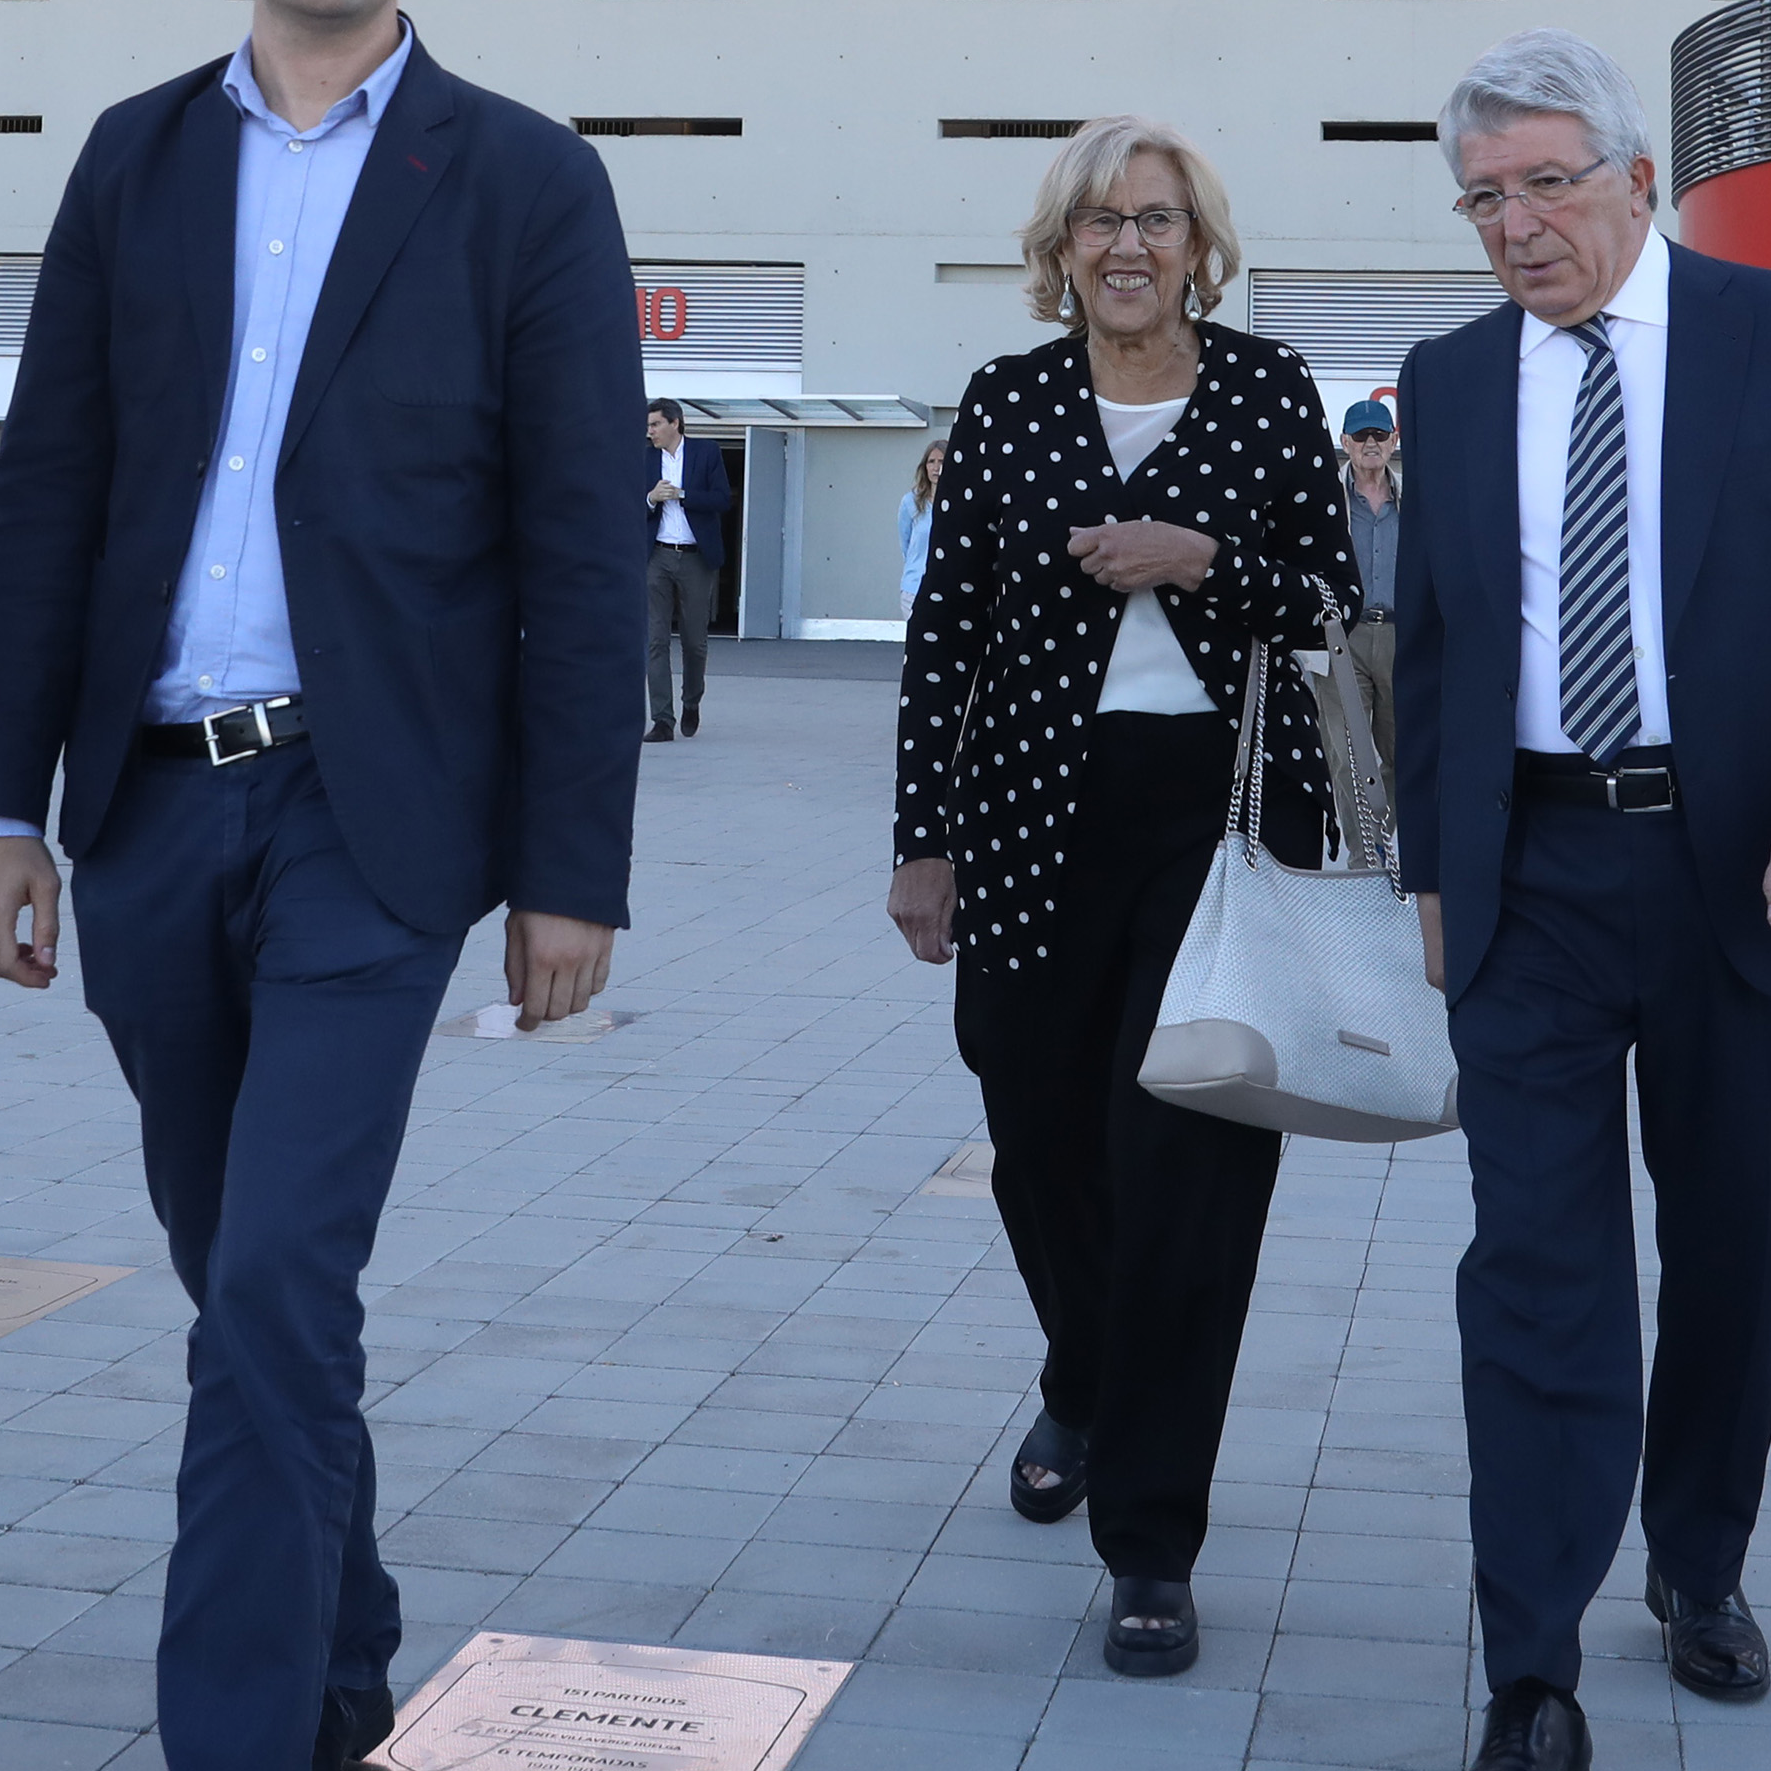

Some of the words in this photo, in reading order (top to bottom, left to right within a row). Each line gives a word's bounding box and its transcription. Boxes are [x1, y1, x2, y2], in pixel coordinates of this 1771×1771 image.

[592, 1690, 688, 1706] PARTIDOS
[510, 1705, 705, 1734] CLEMENTE
[515, 1749, 648, 1769] TEMPORADAS
